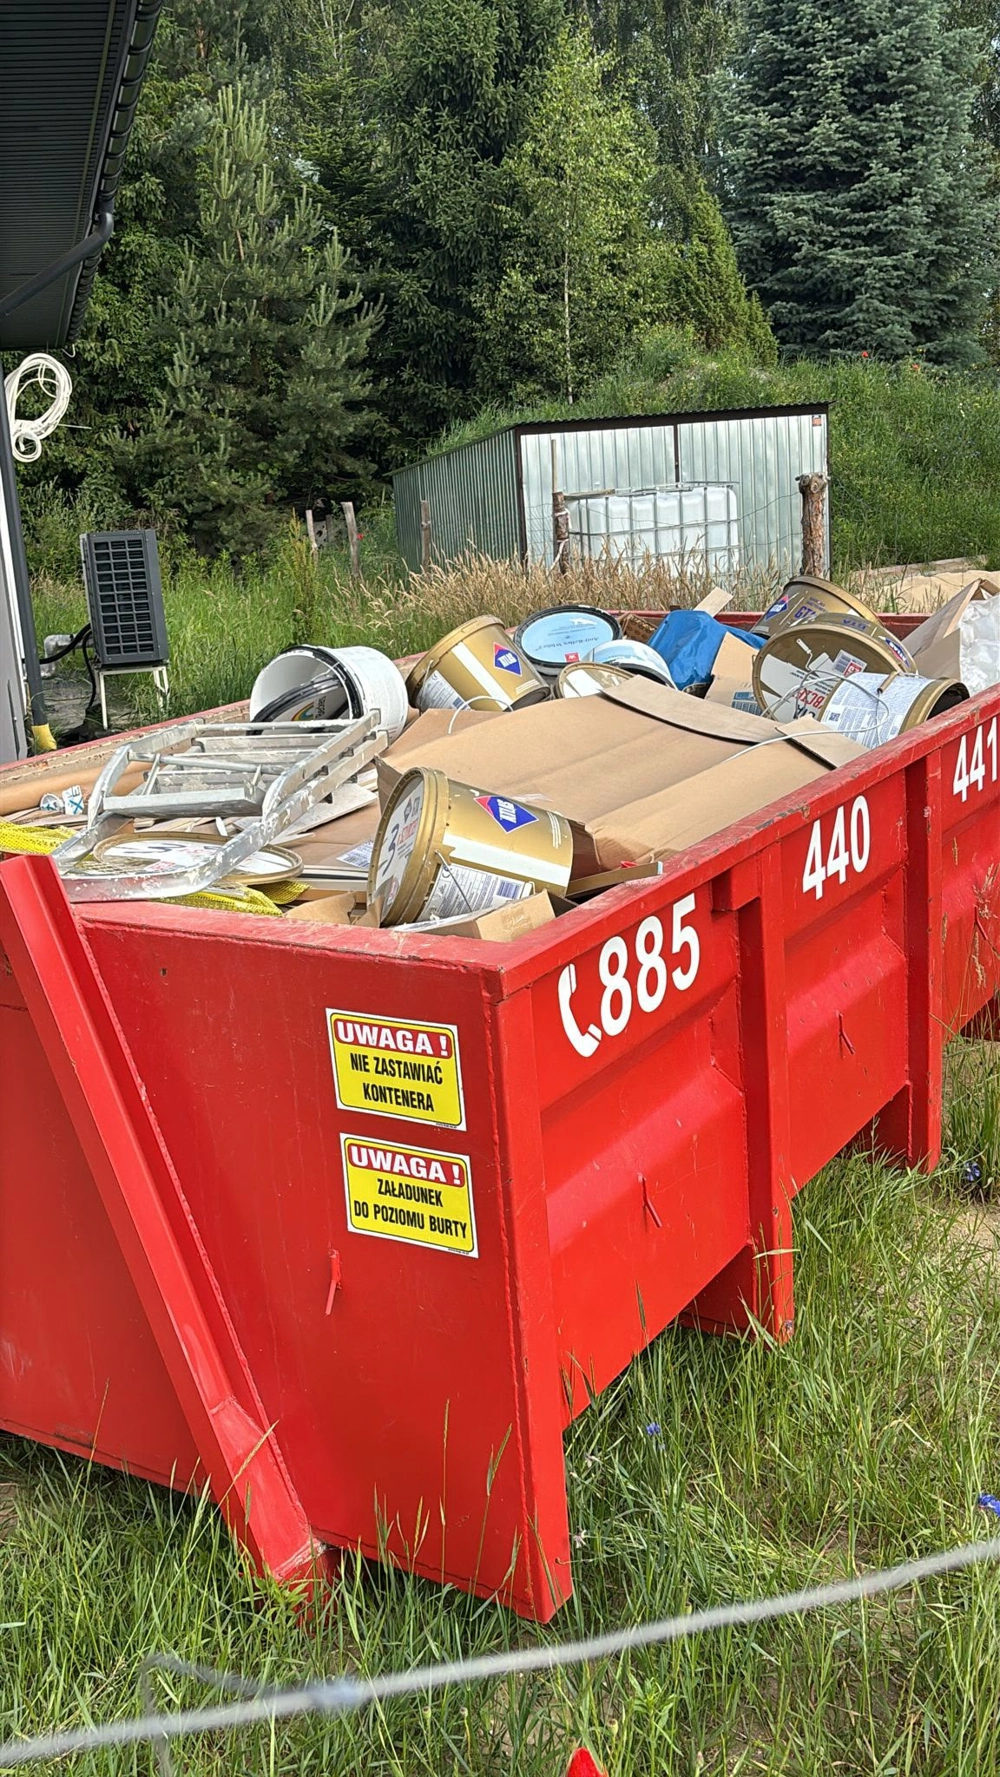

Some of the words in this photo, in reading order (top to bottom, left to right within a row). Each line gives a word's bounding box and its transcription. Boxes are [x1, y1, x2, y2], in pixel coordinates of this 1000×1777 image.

[599, 893, 700, 1037] 885
[802, 795, 870, 900] 440
[952, 717, 998, 802] 441
[337, 1021, 433, 1055] UWAGA
[350, 1052, 370, 1073] NIE
[374, 1056, 443, 1085] ZASTAWIAĆ
[363, 1082, 435, 1112] KONTENERA
[350, 1145, 446, 1183] UWAGA
[377, 1178, 443, 1207] ZAŁADUNEK
[354, 1199, 369, 1218] DO
[373, 1203, 425, 1230] POZIOMU
[429, 1214, 467, 1239] BURTY
